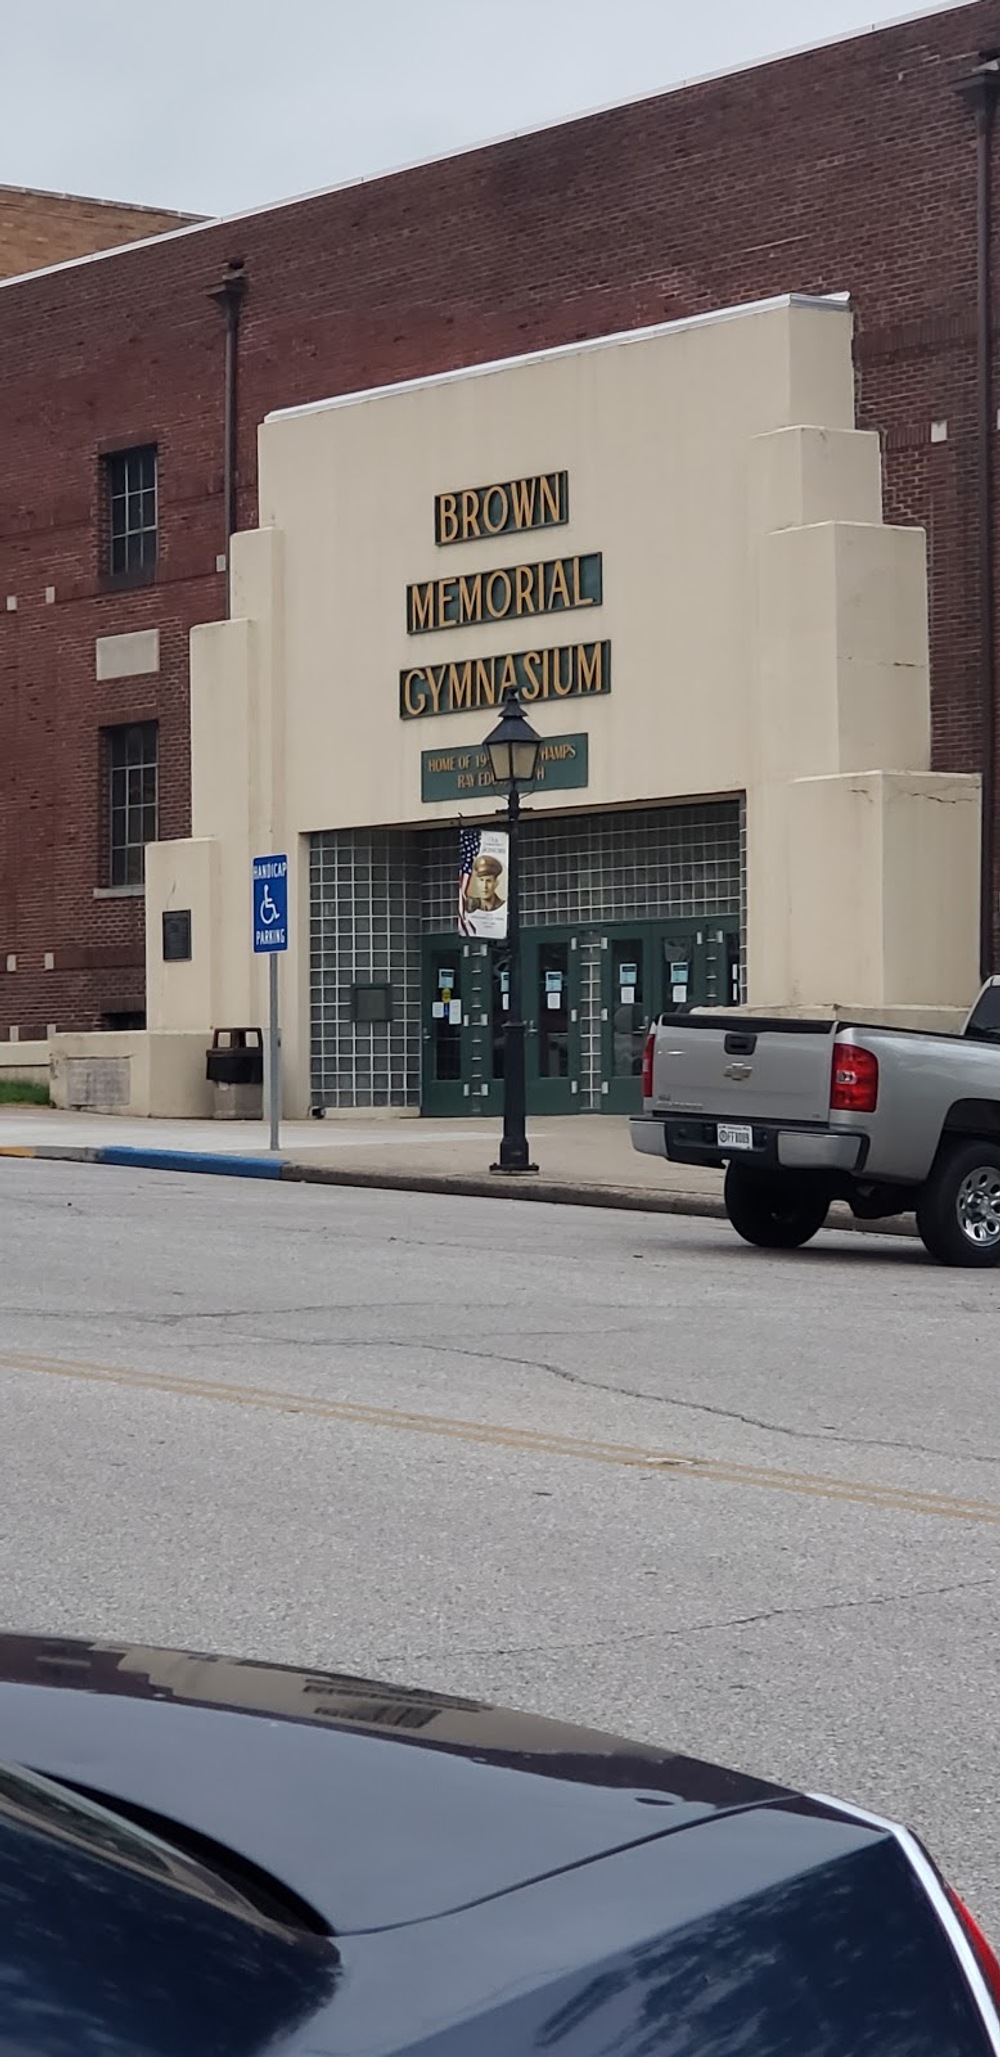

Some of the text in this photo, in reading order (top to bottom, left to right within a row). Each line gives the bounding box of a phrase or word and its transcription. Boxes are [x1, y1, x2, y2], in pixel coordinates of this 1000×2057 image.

[440, 472, 560, 543] BROWN
[412, 556, 594, 631] MEMORIAL
[404, 641, 602, 715] GYMNASIUM
[428, 743, 576, 772] HOME OF 19 HAMPS
[457, 773, 475, 788] RAY
[253, 862, 287, 880] HANDICAP
[256, 928, 285, 945] PARKING
